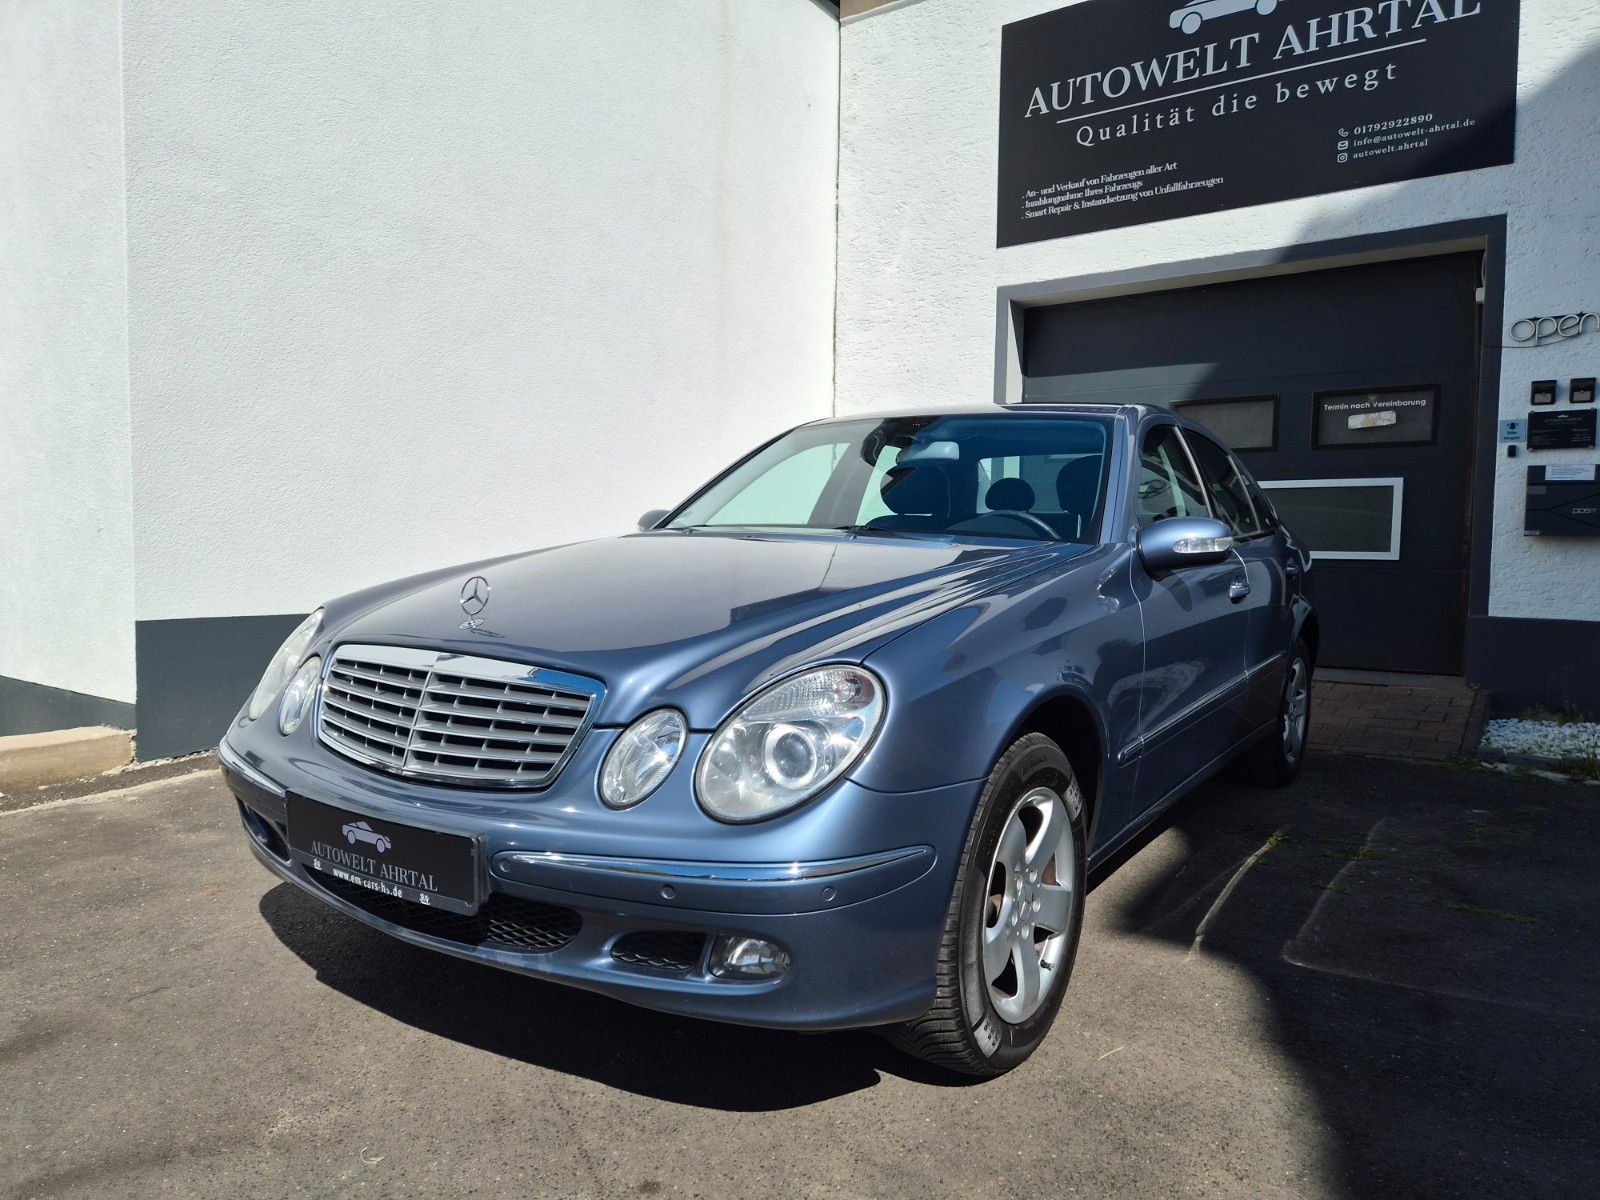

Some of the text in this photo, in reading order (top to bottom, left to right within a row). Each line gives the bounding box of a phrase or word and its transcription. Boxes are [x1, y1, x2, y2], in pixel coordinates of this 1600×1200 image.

[1024, 32, 1260, 118] AUTOWELT
[1076, 63, 1397, 147] Qualität die bewegt
[1353, 113, 1433, 135] 01792922890
[1353, 119, 1476, 147] info@autowelt-ahrtal.de
[1353, 139, 1428, 159] autowelt.ahrtal
[1025, 180, 1144, 209] Inzahlungnahme Ihres Fahrzeugs
[1040, 184, 1055, 195] und
[1056, 178, 1086, 191] Verkauf
[1085, 178, 1100, 186] von
[1101, 169, 1145, 184] Fahrzeugen
[1145, 164, 1163, 175] aller
[1163, 162, 1178, 171] Art
[1025, 177, 1224, 219] Smart Repair & Instandsetzung von Unfallfahrzeugen
[1509, 312, 1600, 345] open
[1324, 402, 1349, 411] Termin
[1372, 399, 1426, 409] Vereinbarung
[311, 840, 438, 892] AUTOWELT AHRTAL
